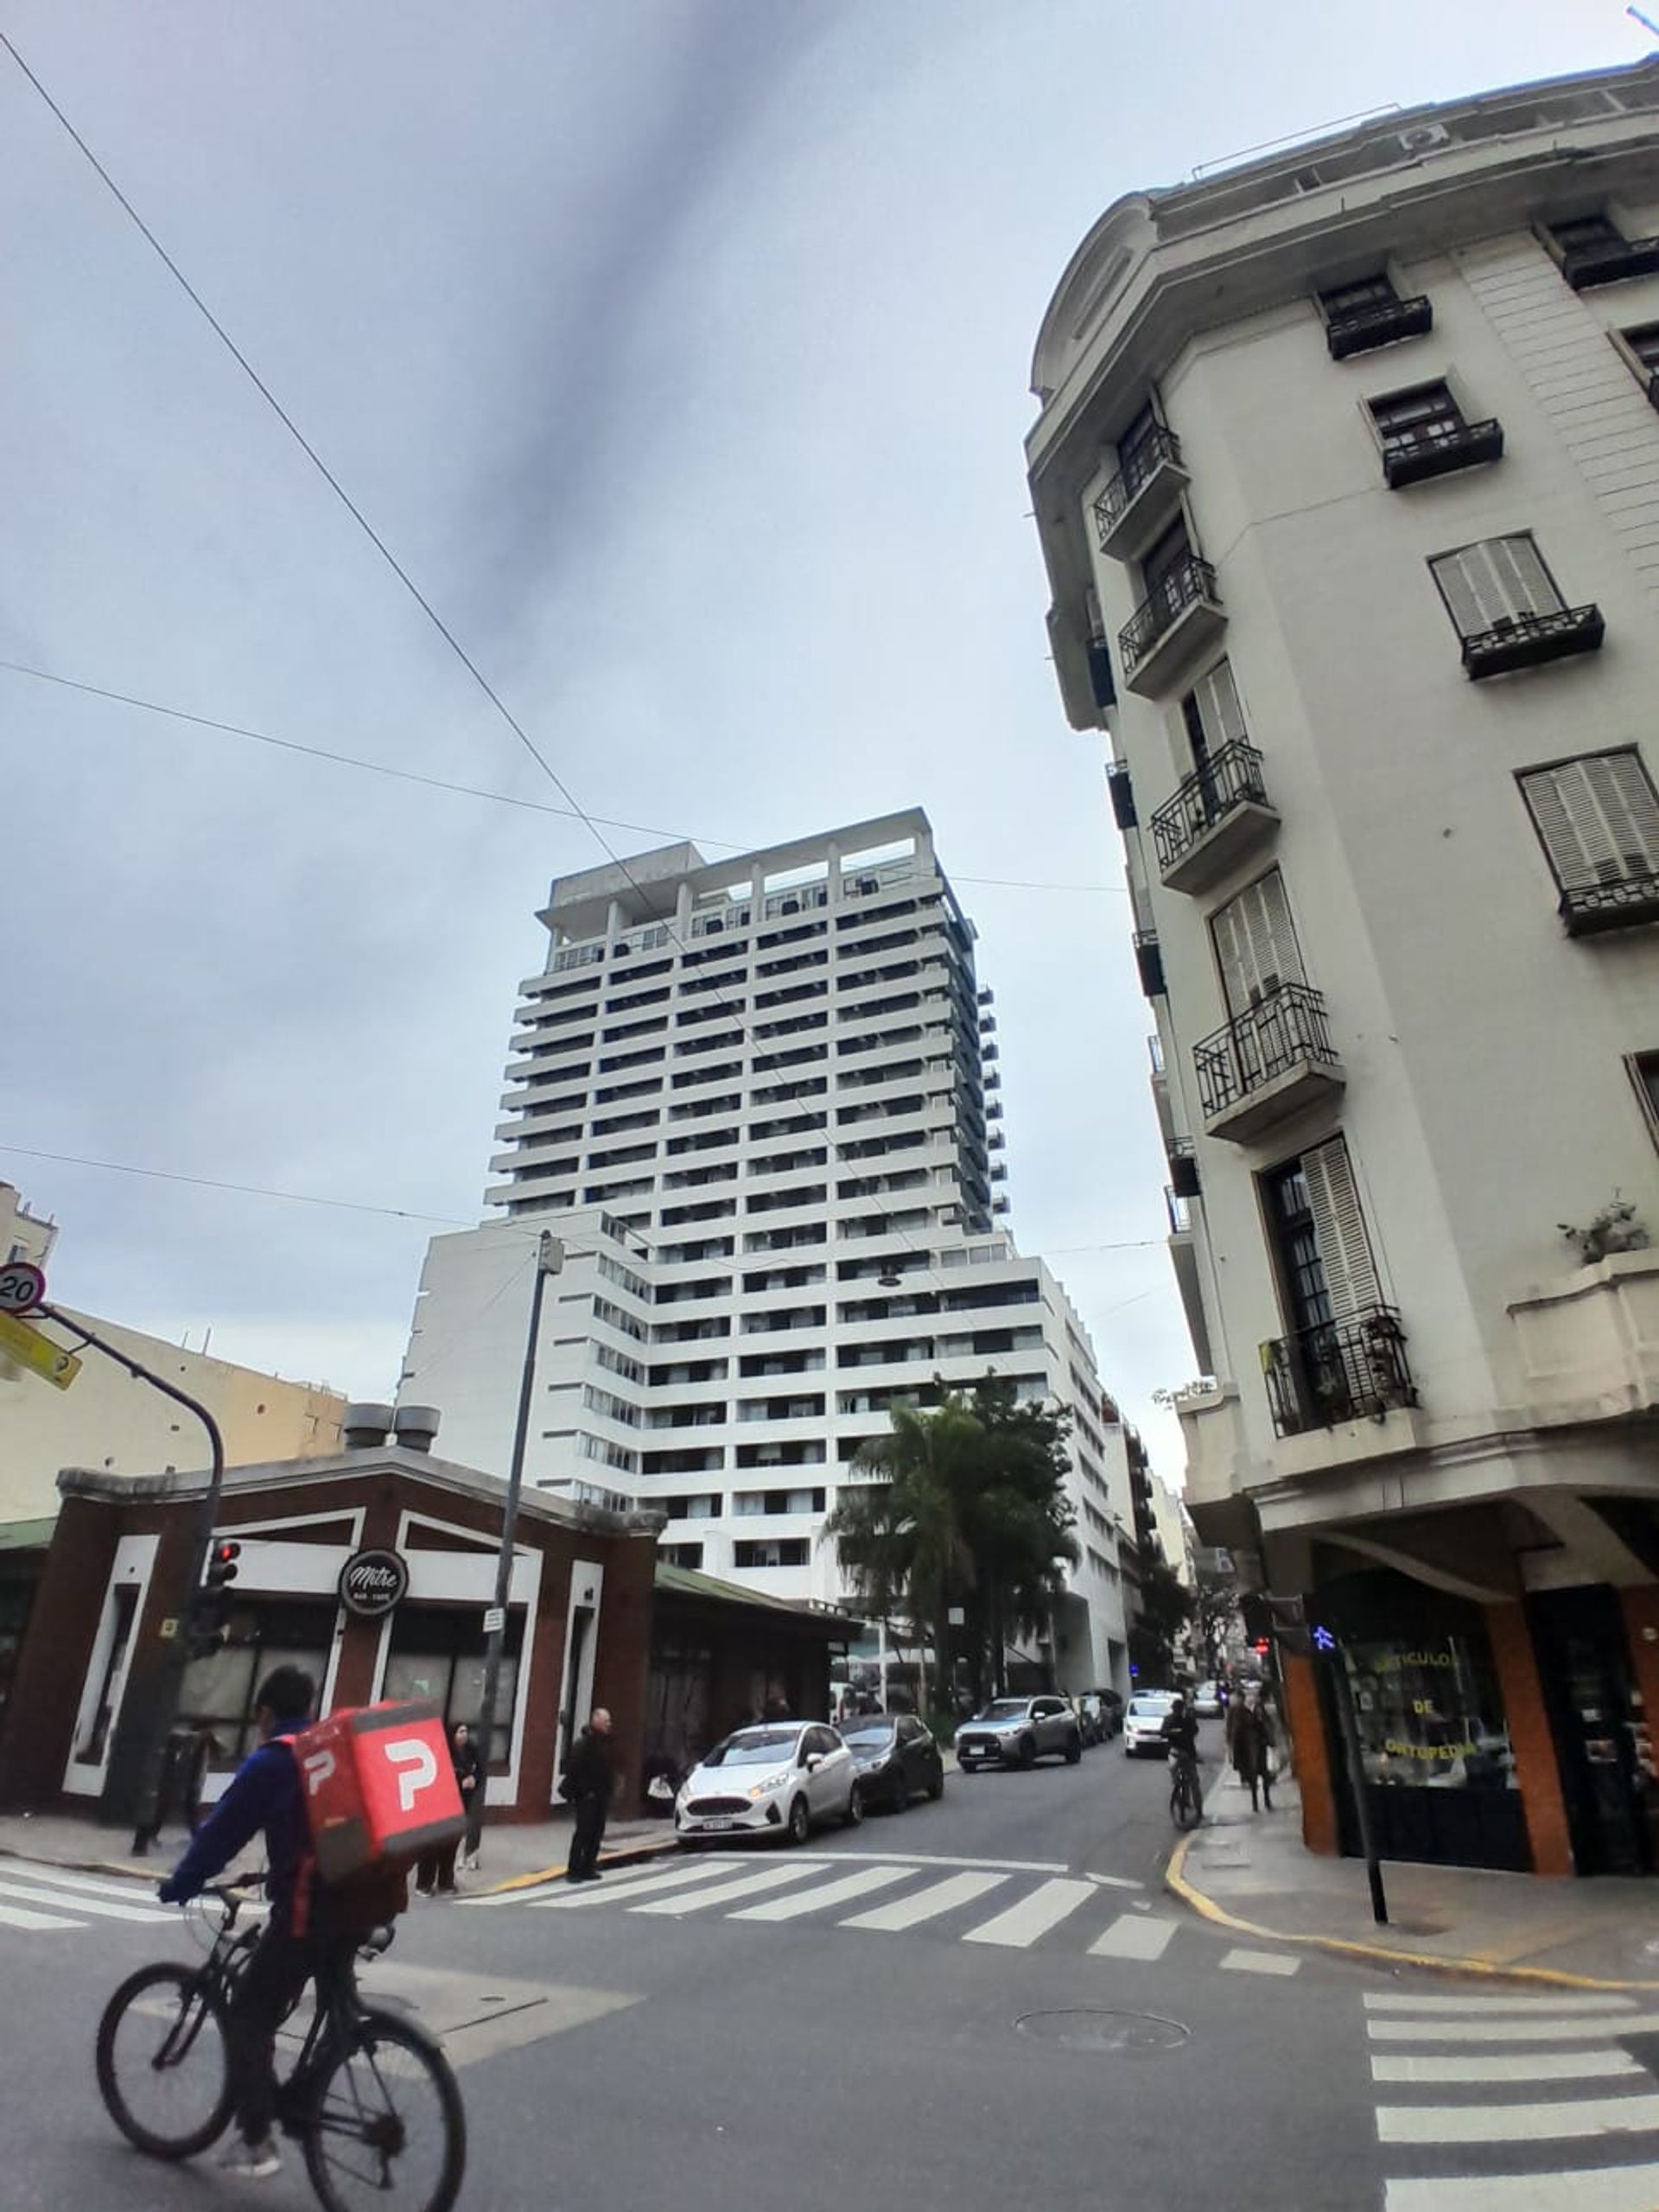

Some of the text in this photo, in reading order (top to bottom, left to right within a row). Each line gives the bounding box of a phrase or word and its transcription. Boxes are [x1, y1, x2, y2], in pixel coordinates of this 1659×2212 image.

[0, 1275, 34, 1301] 20
[350, 1567, 397, 1590] Mitre
[1375, 1651, 1459, 1674] TICULO
[1413, 1699, 1433, 1713] DE
